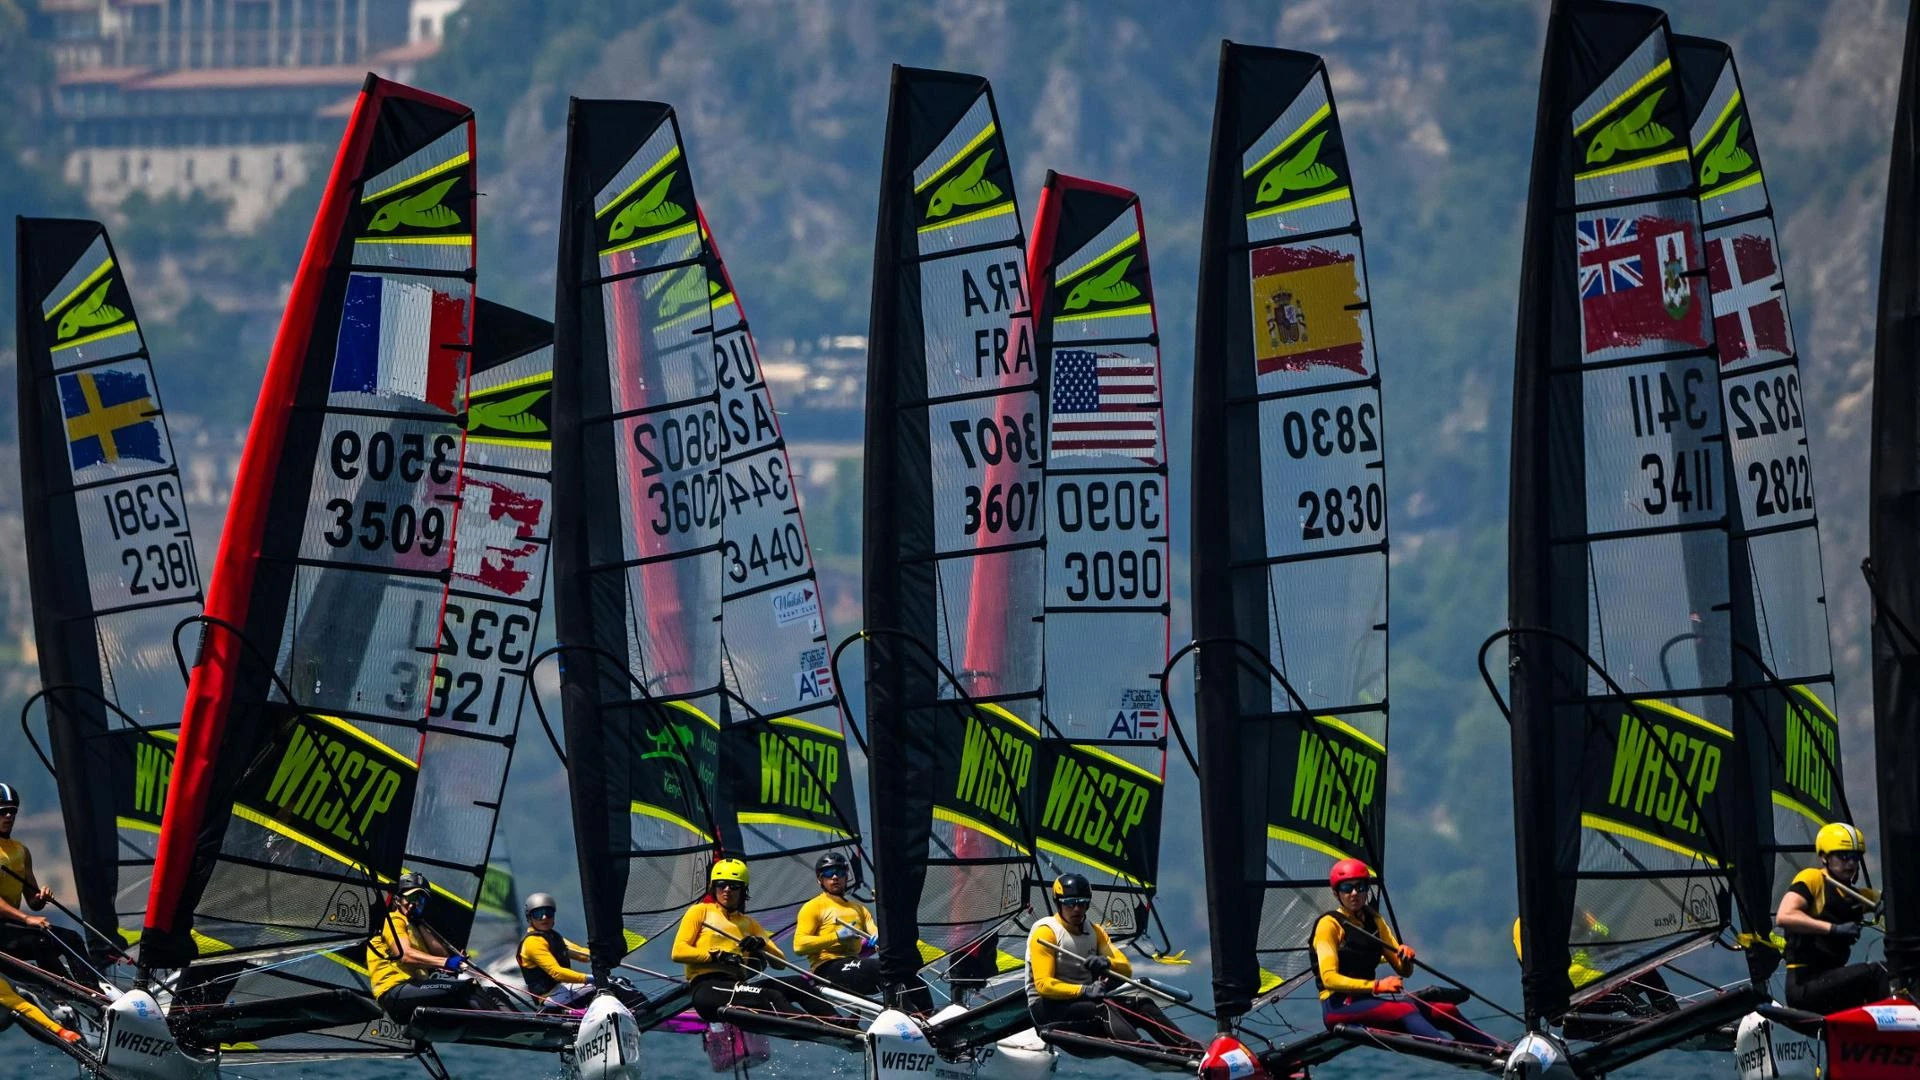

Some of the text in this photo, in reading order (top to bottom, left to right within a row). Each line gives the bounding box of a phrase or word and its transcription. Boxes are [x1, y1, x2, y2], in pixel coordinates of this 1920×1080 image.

[974, 325, 1033, 378] FRA
[648, 474, 720, 535] 3602
[965, 481, 1039, 535] 3607
[1641, 449, 1713, 515] 3411
[1749, 455, 1812, 517] 2822
[324, 499, 445, 556] 3509
[1298, 483, 1382, 540] 2830
[123, 540, 196, 595] 2381
[724, 523, 804, 583] 3440
[1065, 549, 1161, 602] 3090
[265, 724, 401, 845] WASZP
[760, 732, 838, 816] WASZP
[956, 716, 1032, 825] WASZP
[1291, 729, 1377, 844] WASZP
[1608, 714, 1721, 834] WASZP
[1041, 754, 1149, 858] WASZP
[115, 1030, 174, 1057] WASZP
[577, 1032, 611, 1063] WASZP
[881, 1051, 935, 1072] WASZP
[1738, 1047, 1766, 1073] WASZP
[1775, 1040, 1807, 1061] WASZP
[1840, 1041, 1920, 1065] WAS
